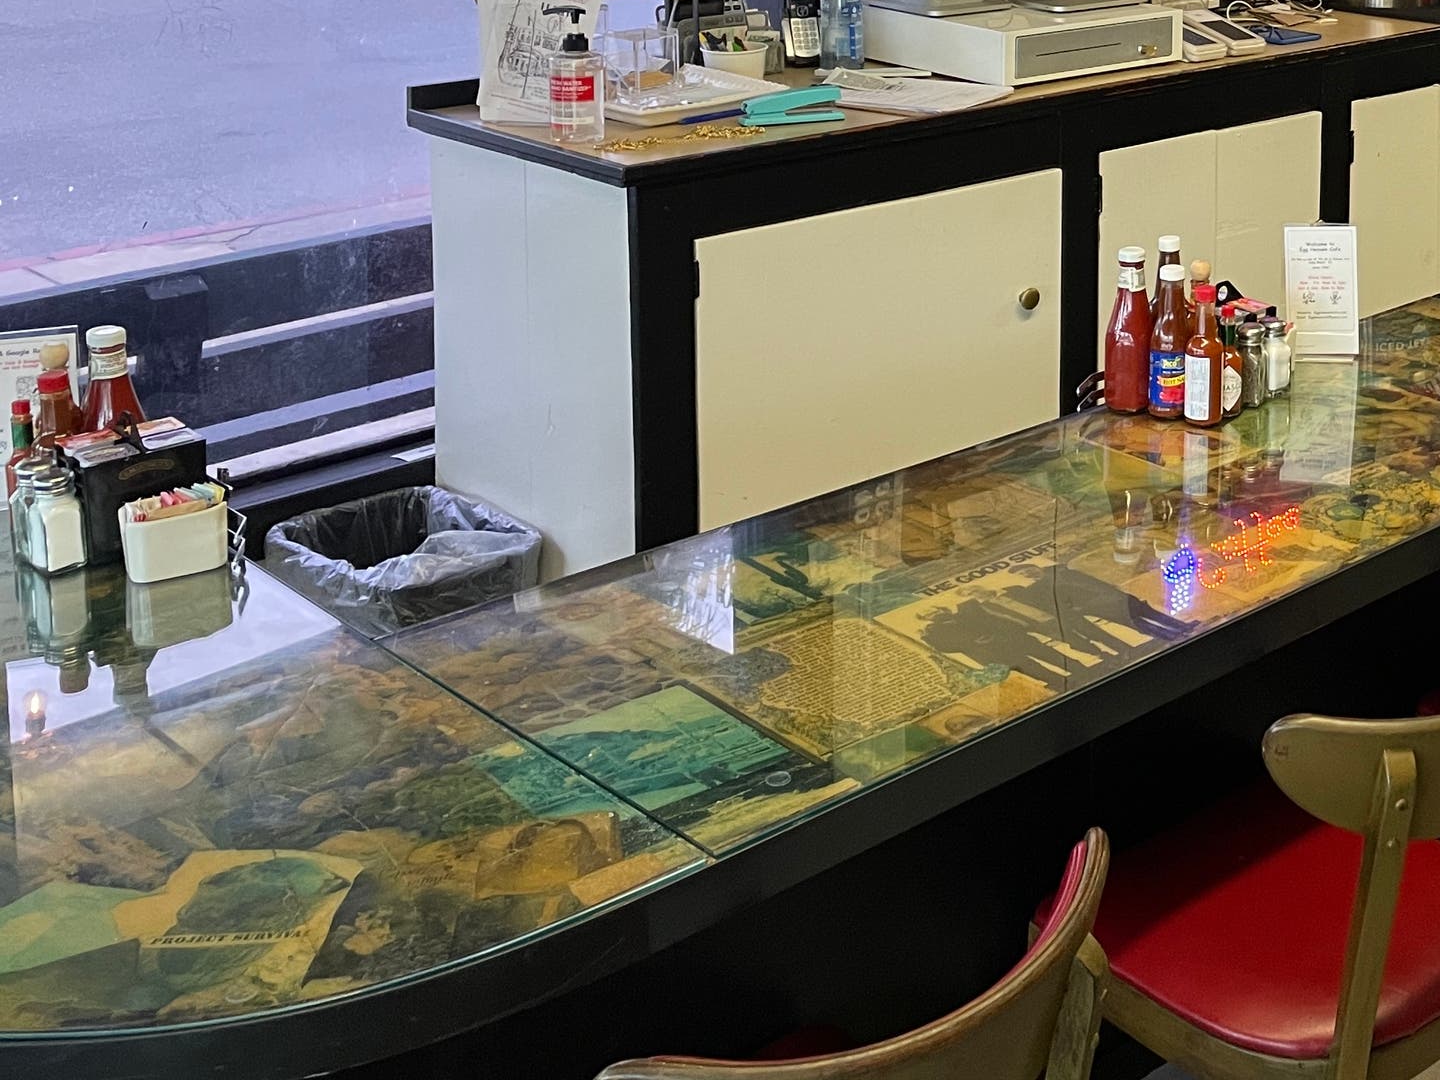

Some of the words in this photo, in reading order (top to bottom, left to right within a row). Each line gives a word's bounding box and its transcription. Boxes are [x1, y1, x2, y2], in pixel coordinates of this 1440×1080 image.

[916, 580, 958, 596] THE
[955, 560, 1010, 584] GOOD
[150, 934, 228, 946] PROJECT
